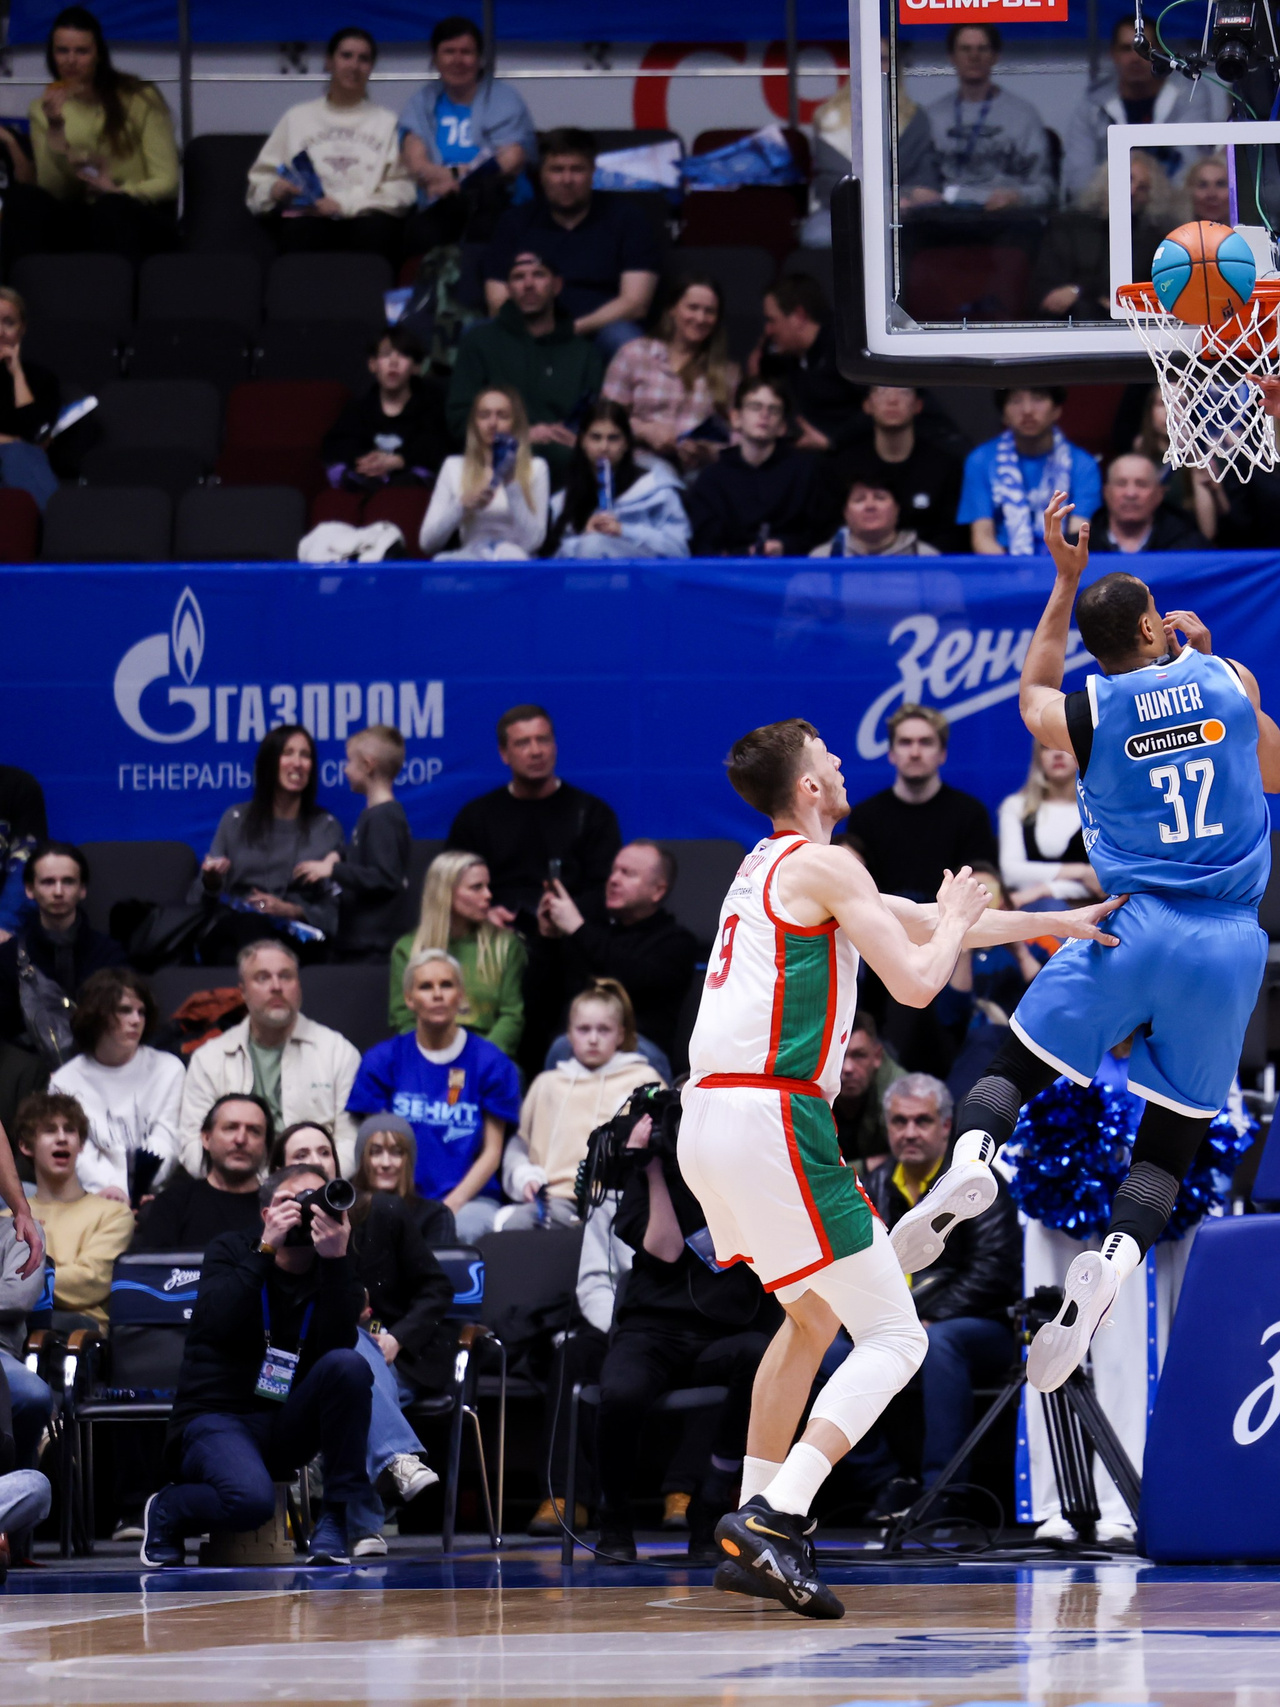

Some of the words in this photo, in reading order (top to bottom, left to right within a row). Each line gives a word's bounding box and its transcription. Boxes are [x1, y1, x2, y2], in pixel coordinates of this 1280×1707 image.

[215, 680, 444, 742] ГАЗПРОМ
[1134, 682, 1204, 722] HUNTER
[1133, 731, 1198, 754] Winline
[118, 763, 253, 791] ГЕНЕРАЛЬ
[1149, 757, 1224, 844] 32
[706, 913, 740, 990] 9
[393, 1094, 479, 1122] ЗЕНИТ
